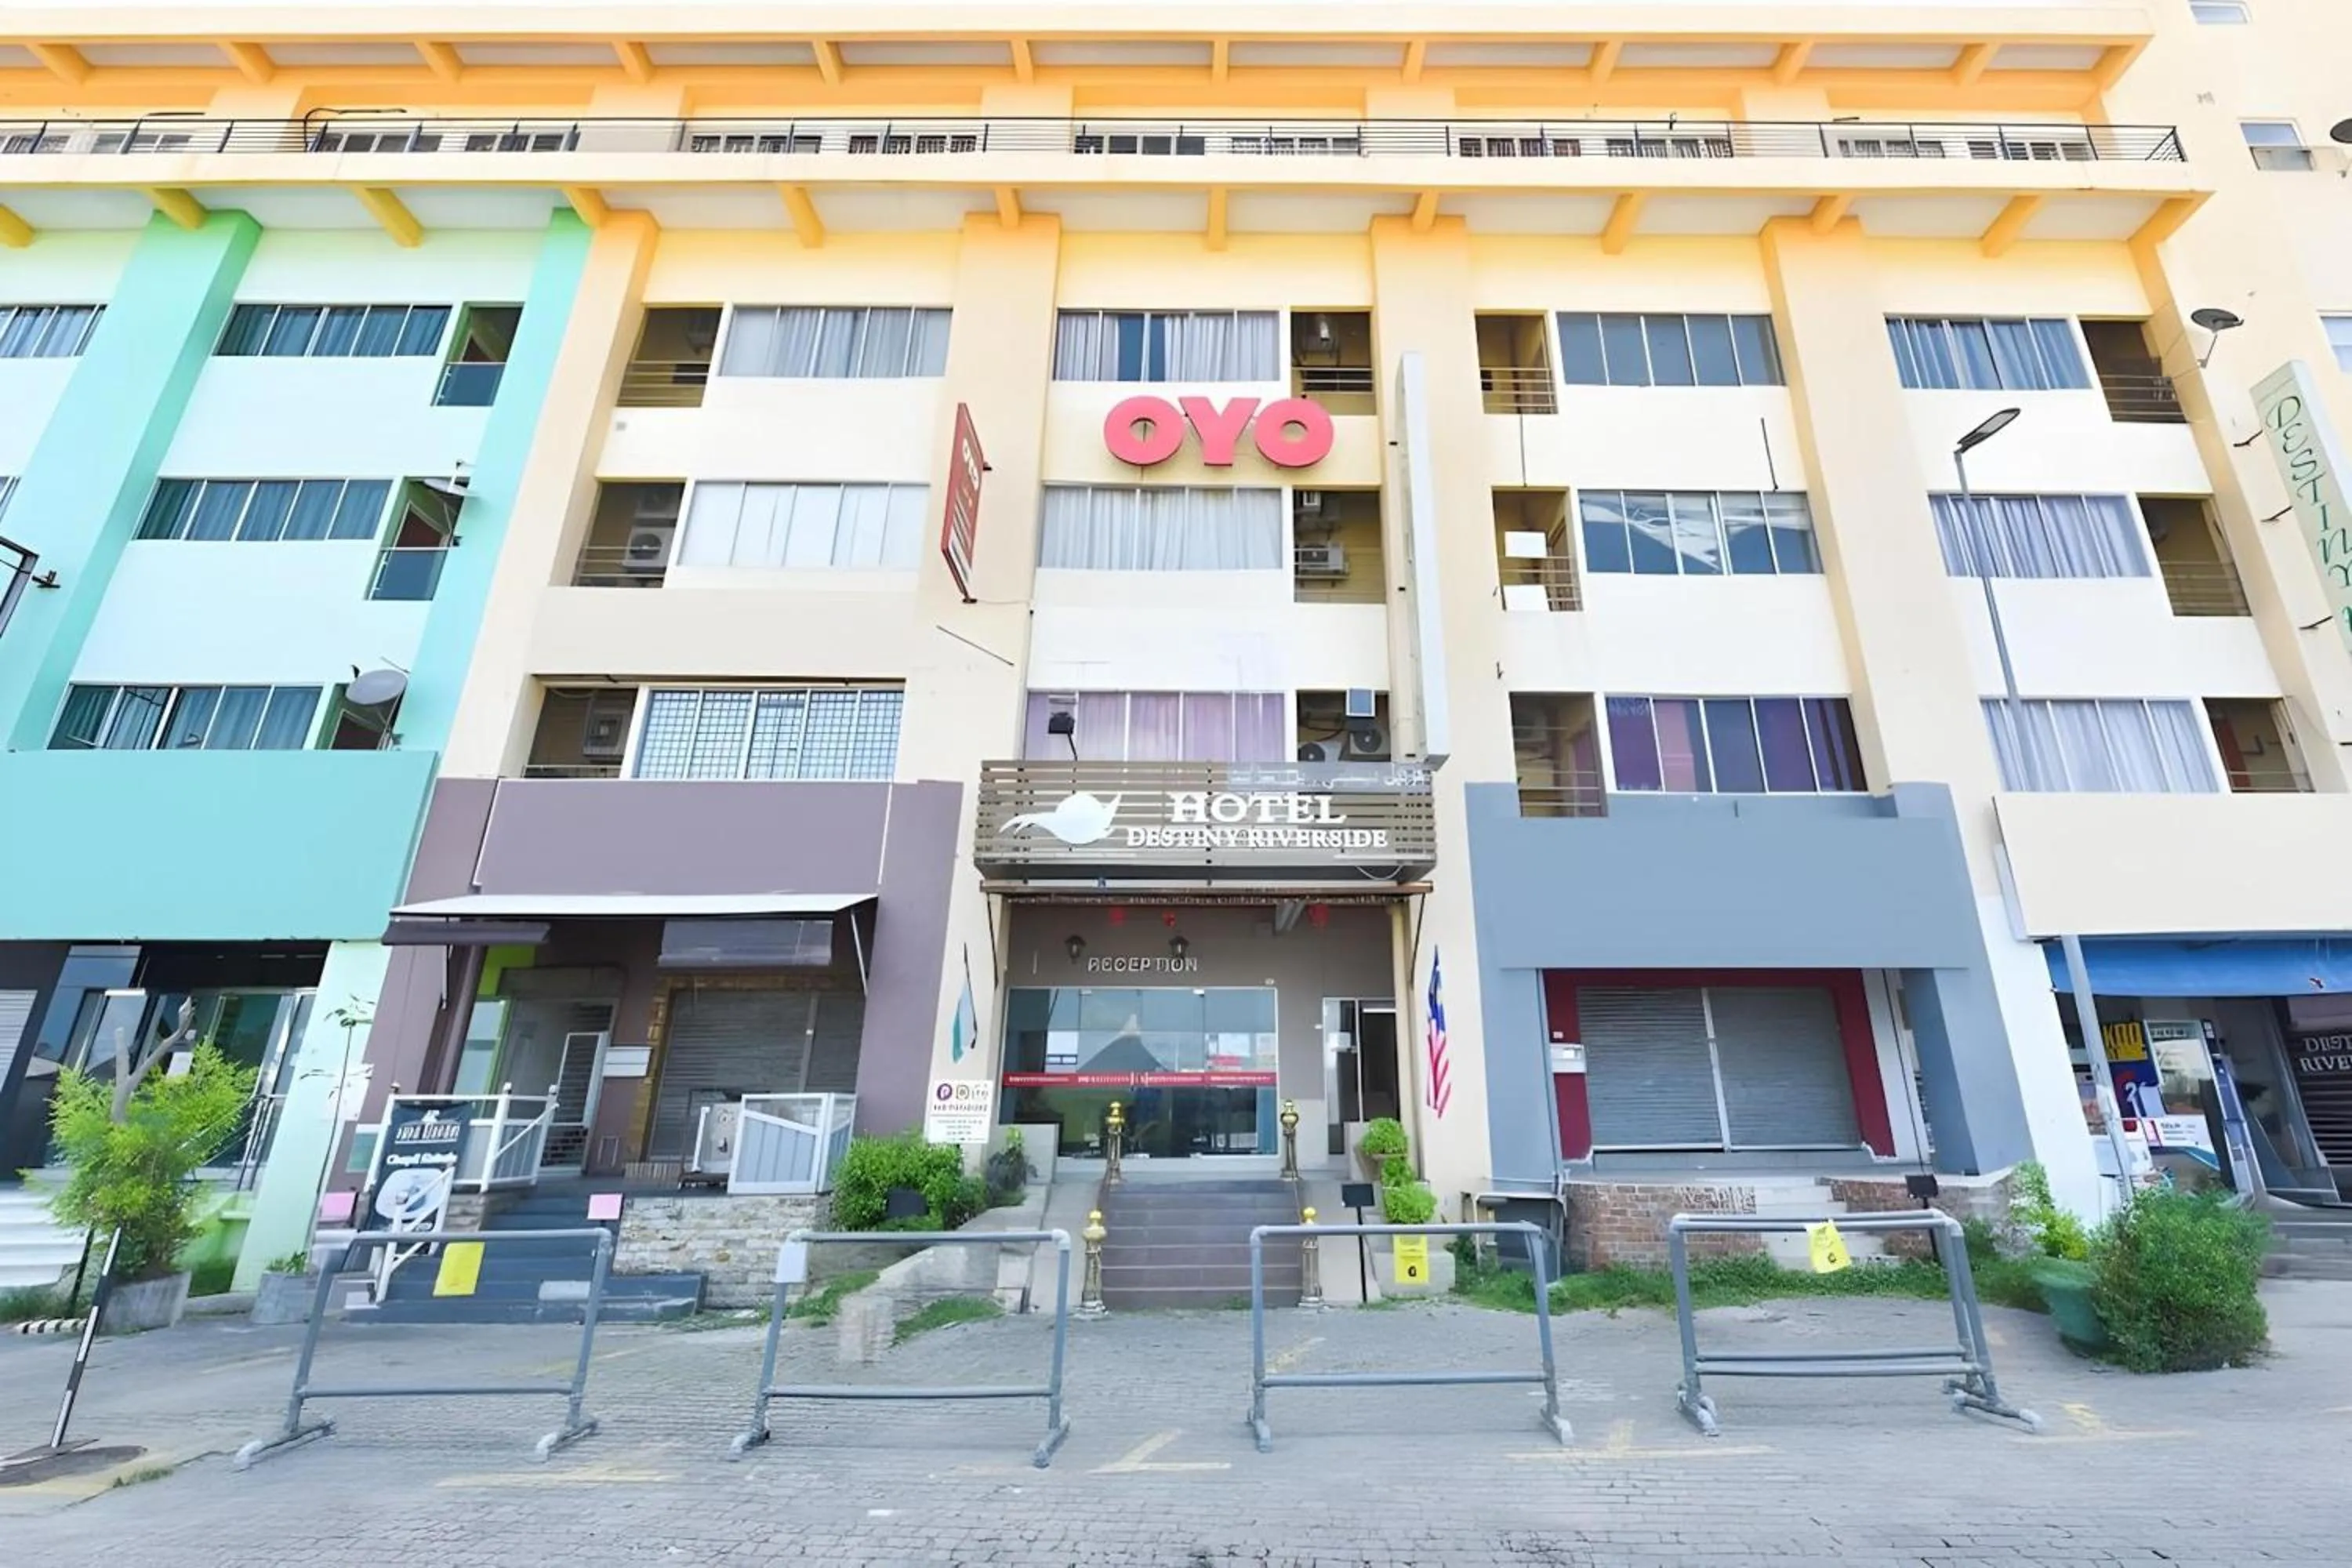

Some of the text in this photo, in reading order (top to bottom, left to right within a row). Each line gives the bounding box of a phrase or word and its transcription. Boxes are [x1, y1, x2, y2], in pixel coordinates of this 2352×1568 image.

[1104, 395, 1334, 467] OYO
[1171, 792, 1347, 823] HOTEL
[1127, 827, 1389, 848] DESTINY RIVERSIDE
[1087, 956, 1198, 972] RECEPTION
[2299, 1055, 2352, 1073] RIVE
